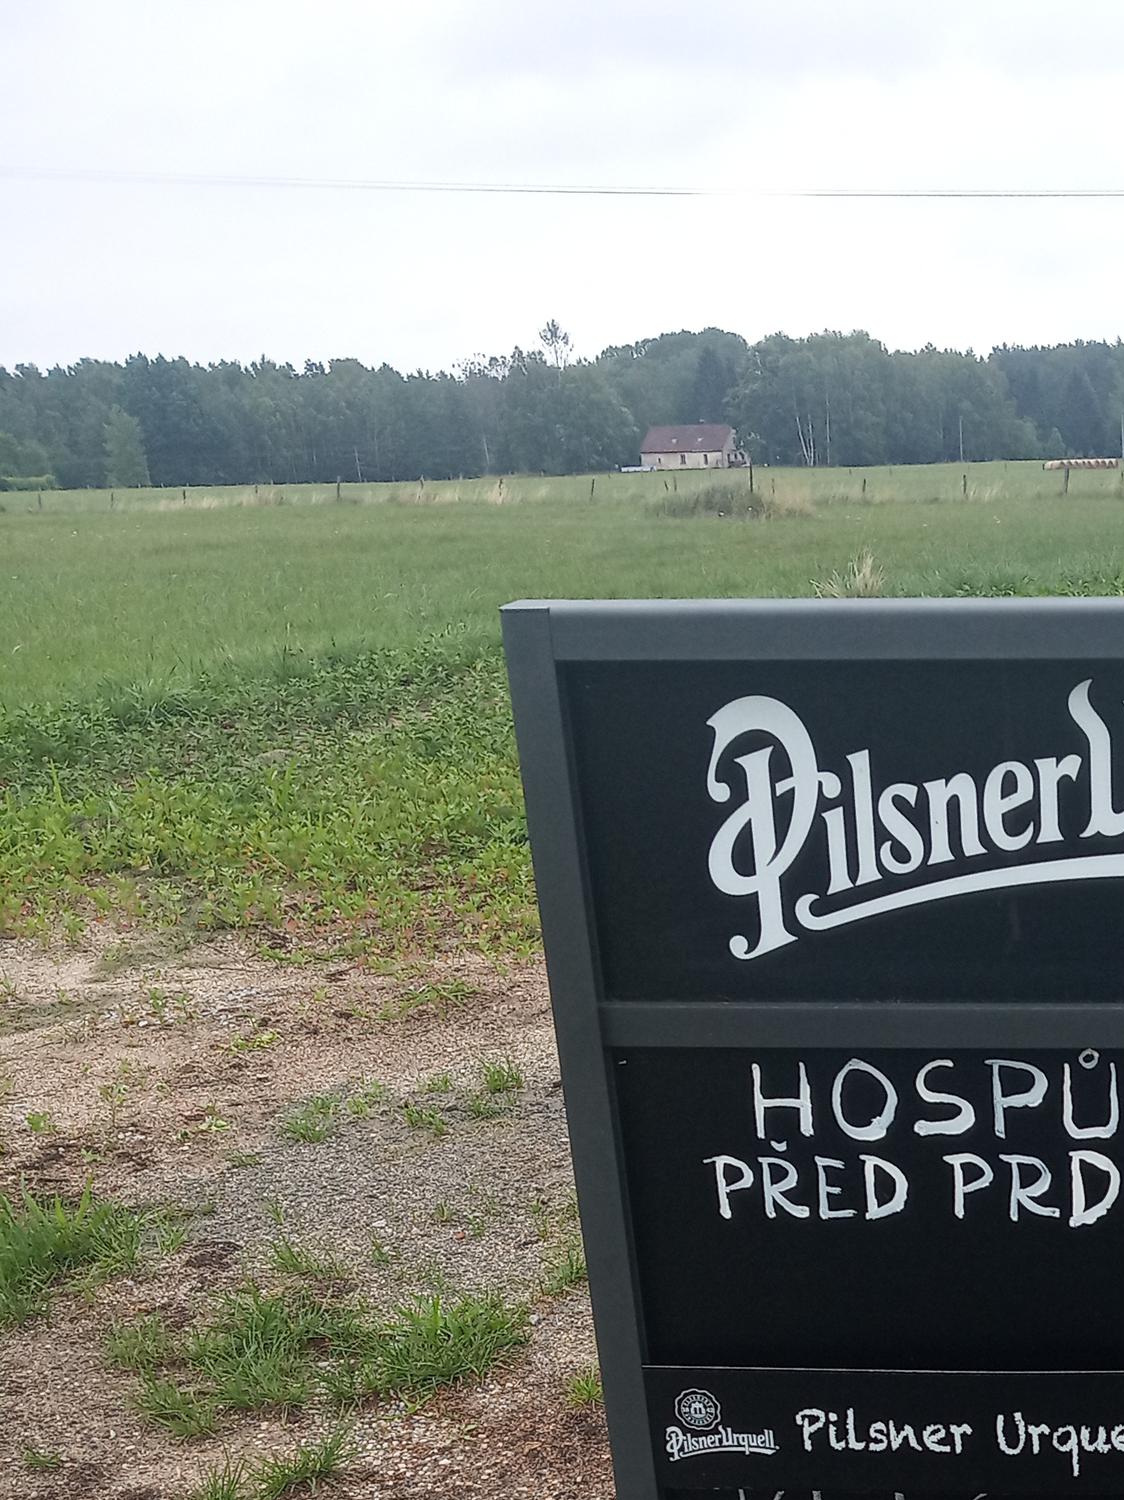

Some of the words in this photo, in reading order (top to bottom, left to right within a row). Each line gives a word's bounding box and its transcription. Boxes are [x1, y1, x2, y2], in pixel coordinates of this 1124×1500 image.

[706, 695, 1081, 959] Pilsner
[703, 1142, 908, 1220] PŘED
[795, 1408, 973, 1453] Pilsner
